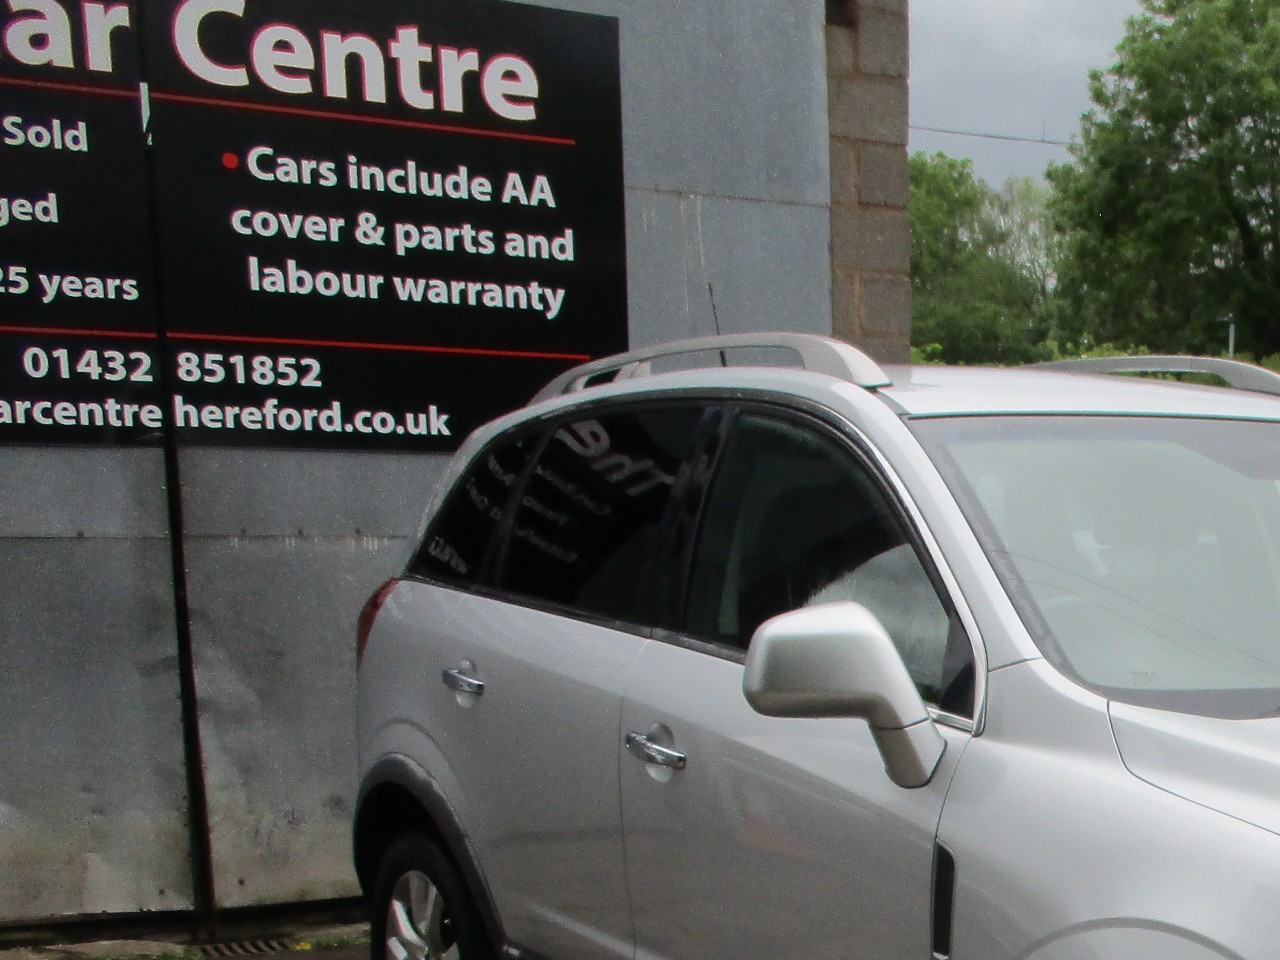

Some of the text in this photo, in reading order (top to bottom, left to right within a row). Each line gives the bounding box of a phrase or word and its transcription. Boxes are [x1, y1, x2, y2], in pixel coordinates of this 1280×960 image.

[3, 0, 540, 121] ar Centre
[2, 115, 88, 152] Sold
[247, 146, 556, 208] Cars include AA
[231, 209, 574, 261] cover & parts and
[0, 266, 139, 304] 5 years
[248, 256, 566, 320] labour warranty
[23, 346, 322, 387] 01432 851852
